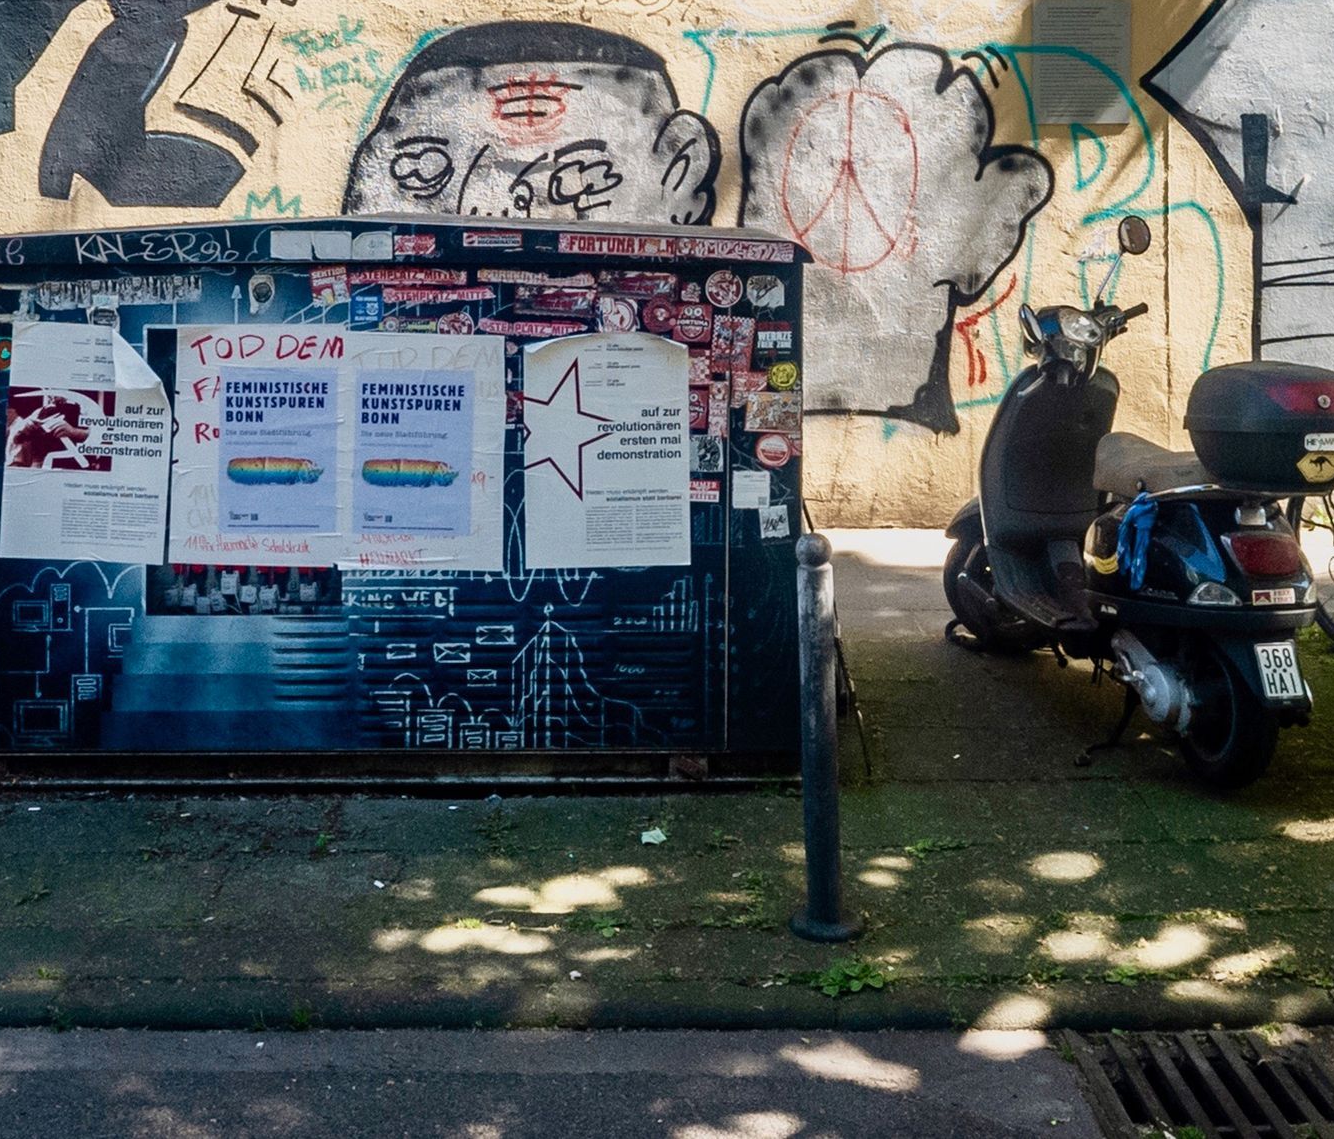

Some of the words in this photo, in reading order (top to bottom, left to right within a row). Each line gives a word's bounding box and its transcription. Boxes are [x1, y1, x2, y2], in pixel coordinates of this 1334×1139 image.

[568, 235, 635, 253] FORTUNA
[394, 290, 451, 302] STEHPLATZ
[456, 289, 488, 300] MITTE
[489, 322, 546, 335] STEHPLATZ
[190, 334, 265, 365] TOD
[276, 334, 345, 360] DEM
[225, 382, 329, 394] FEMINISTISCHE
[361, 383, 466, 397] FEMINISTISCHE
[225, 396, 325, 408] KUNSTSPUREN
[361, 397, 462, 411] KUNSTSPUREN
[125, 405, 144, 415] auf
[146, 408, 166, 416] zur
[225, 410, 264, 423] BONN
[641, 406, 661, 417] auf
[663, 409, 682, 417] zur
[80, 416, 164, 429] revolutionären
[361, 412, 400, 424] BONN
[597, 421, 682, 432] revolutionären
[101, 432, 139, 442] ersten
[142, 433, 164, 444] mai
[620, 436, 657, 446] ersten
[660, 435, 682, 445] mai
[78, 444, 163, 458] demonstration
[597, 449, 682, 461] demonstration
[1261, 646, 1294, 669] 368
[1267, 673, 1299, 697] HAI
